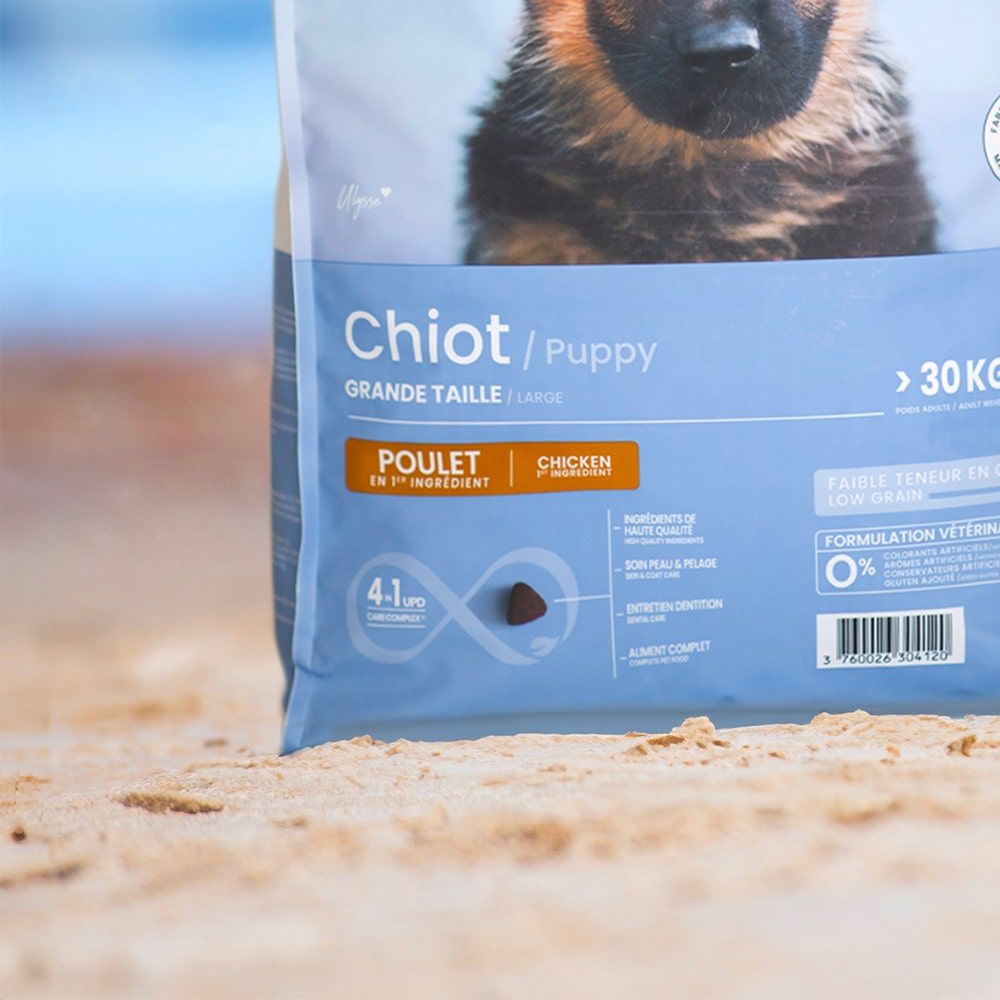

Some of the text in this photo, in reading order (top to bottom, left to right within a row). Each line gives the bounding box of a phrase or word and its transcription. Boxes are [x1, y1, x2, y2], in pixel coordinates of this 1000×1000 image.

[344, 308, 510, 366] Chiot
[546, 338, 658, 374] Puppy
[344, 379, 427, 404] GRANDE
[431, 384, 502, 404] TAILLE
[517, 391, 564, 405] LARGE
[895, 405, 920, 415] POIDS
[377, 449, 481, 475] POULET
[537, 455, 612, 470] CHICKEN
[369, 475, 385, 487] EN
[410, 473, 490, 489] INGRÉDIENT
[827, 473, 887, 490] FAIBLE
[896, 466, 962, 485] TENEUR
[968, 464, 989, 480] EN
[828, 488, 923, 508] LOW GRAIN
[684, 513, 696, 524] DE
[624, 525, 655, 536] HAUTE
[825, 528, 936, 548] FORMULATION
[883, 547, 938, 560] COLORANTS
[625, 559, 648, 571] SOIN
[649, 559, 673, 570] PEAU
[683, 557, 718, 569] PELAGE
[883, 564, 960, 579] CONSERVATEURS
[884, 576, 919, 588] GLUTEN
[626, 598, 724, 615] ENTRETIEN DENTITION
[629, 640, 711, 658] ALIMENT COMPLET
[842, 653, 892, 664] 760026
[896, 650, 949, 663] 304120
